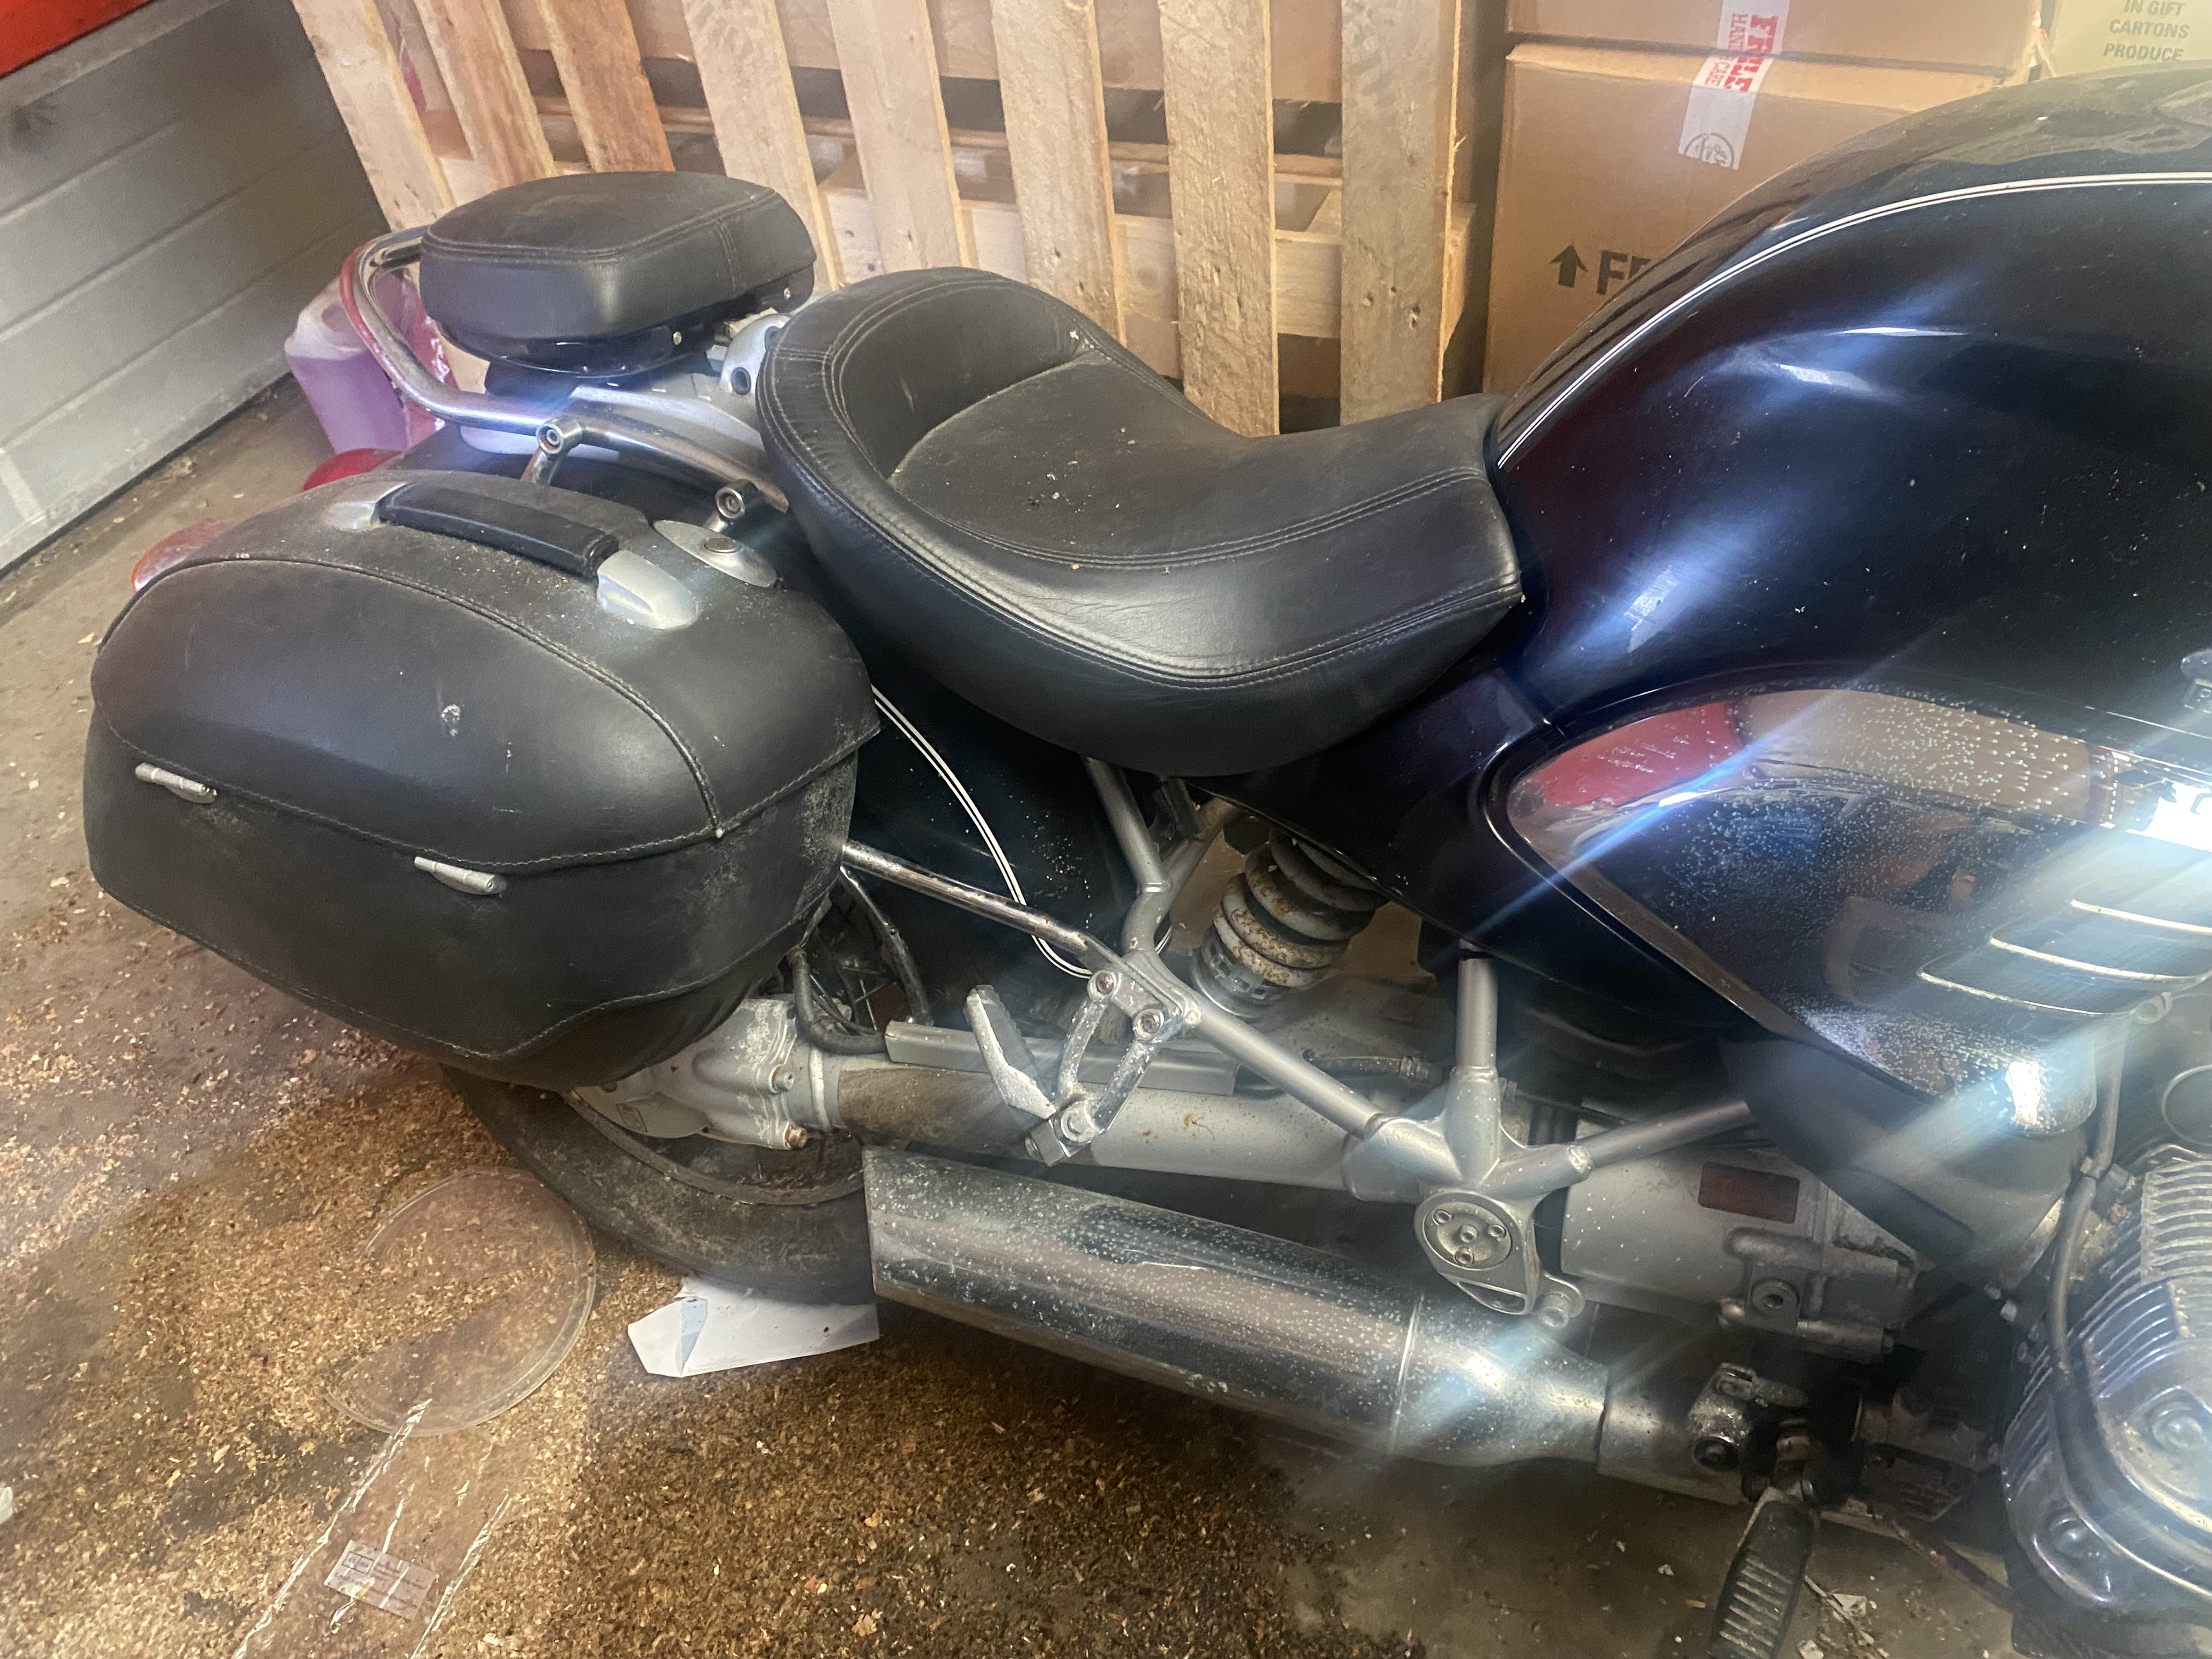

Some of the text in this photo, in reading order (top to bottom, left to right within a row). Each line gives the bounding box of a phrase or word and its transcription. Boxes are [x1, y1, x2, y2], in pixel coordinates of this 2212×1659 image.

[2123, 0, 2186, 16] IN GIFT
[2109, 19, 2191, 39] CARTONS
[2102, 43, 2185, 62] PRODUCE
